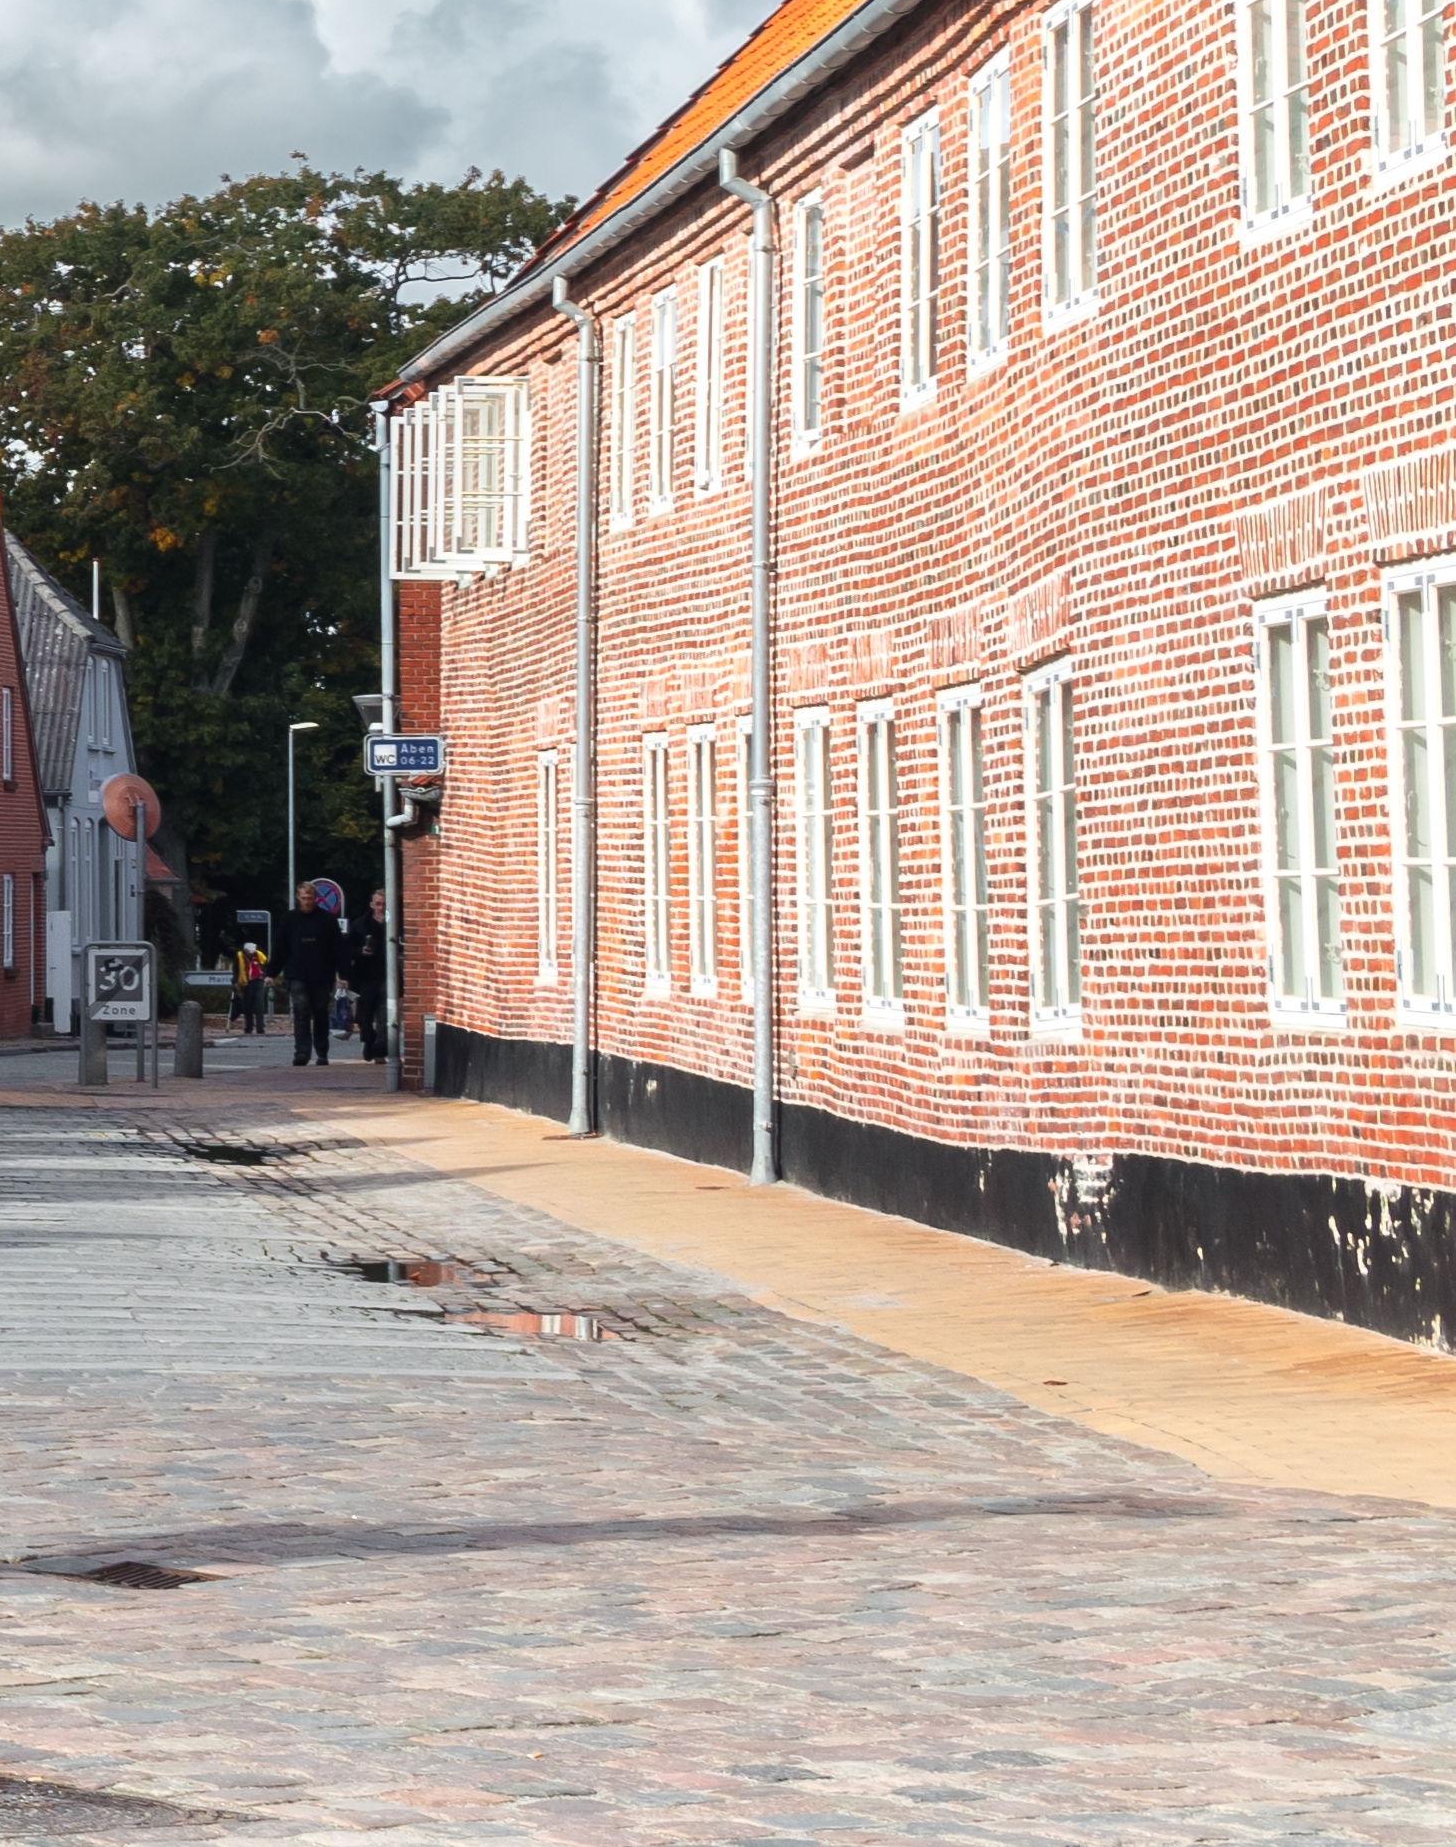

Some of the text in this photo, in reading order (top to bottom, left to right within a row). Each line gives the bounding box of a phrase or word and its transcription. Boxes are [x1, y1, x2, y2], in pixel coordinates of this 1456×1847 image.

[375, 754, 396, 764] WC
[400, 756, 435, 765] 06-22
[99, 966, 139, 991] 30
[102, 1005, 136, 1015] Zone
